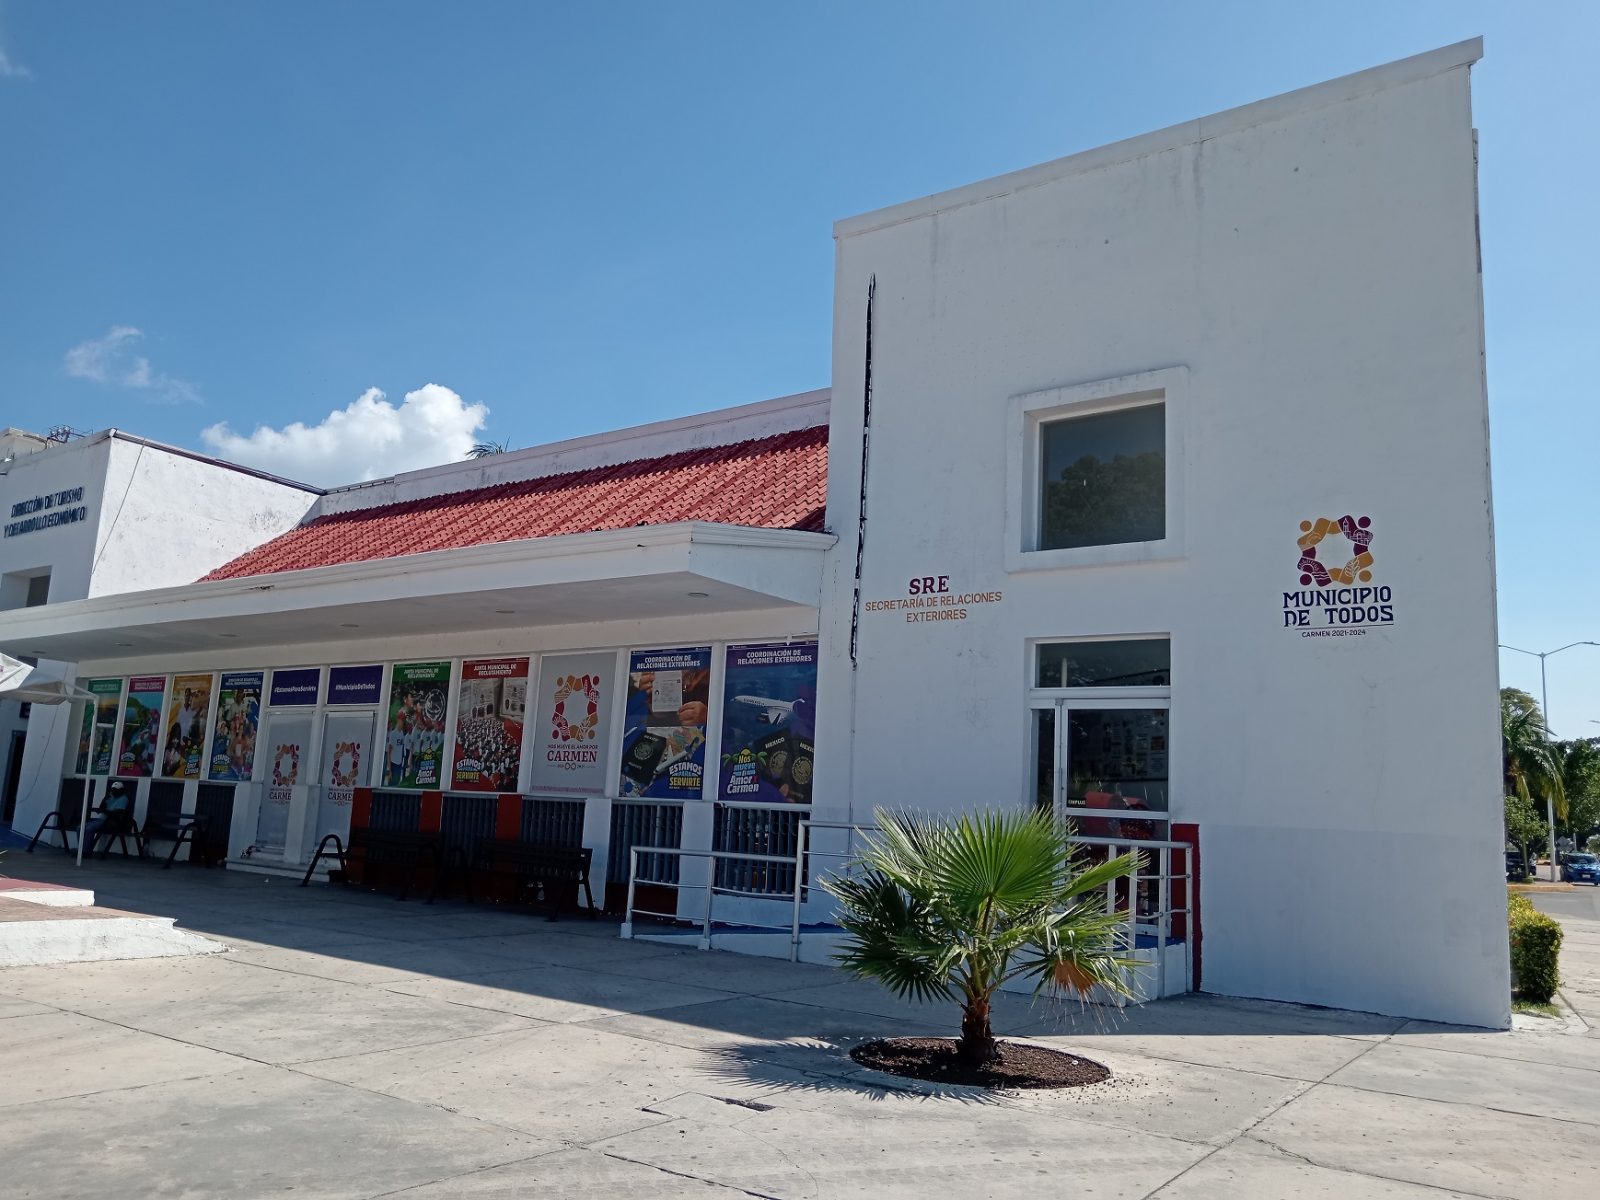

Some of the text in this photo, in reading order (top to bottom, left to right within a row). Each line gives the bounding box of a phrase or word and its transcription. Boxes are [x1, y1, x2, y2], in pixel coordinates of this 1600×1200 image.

[45, 494, 54, 509] DE
[54, 487, 83, 507] TURISMO
[4, 525, 9, 538] Y
[909, 575, 950, 595] SRE
[865, 591, 1002, 611] SECRETARÍA DE RELACIONES
[1283, 585, 1392, 609] MUNICIPIO
[906, 609, 967, 623] EXTERIORES
[1284, 605, 1394, 627] DE TODOS
[1302, 629, 1366, 638] CARMEN 2021-2024
[644, 654, 683, 663] COORDINACIÓN
[745, 650, 792, 658] COORDINACIÓN
[636, 660, 701, 669] RELACIONES EXTERIORES
[737, 655, 812, 665] RELACIONES EXTERIORES
[547, 750, 598, 763] CARMEN
[738, 755, 751, 764] Nos
[669, 761, 703, 775] ESTAMOS
[669, 777, 701, 787] SERVIRTE
[727, 784, 760, 794] Carmen
[269, 791, 291, 801] CARME
[327, 791, 352, 801] CARME
